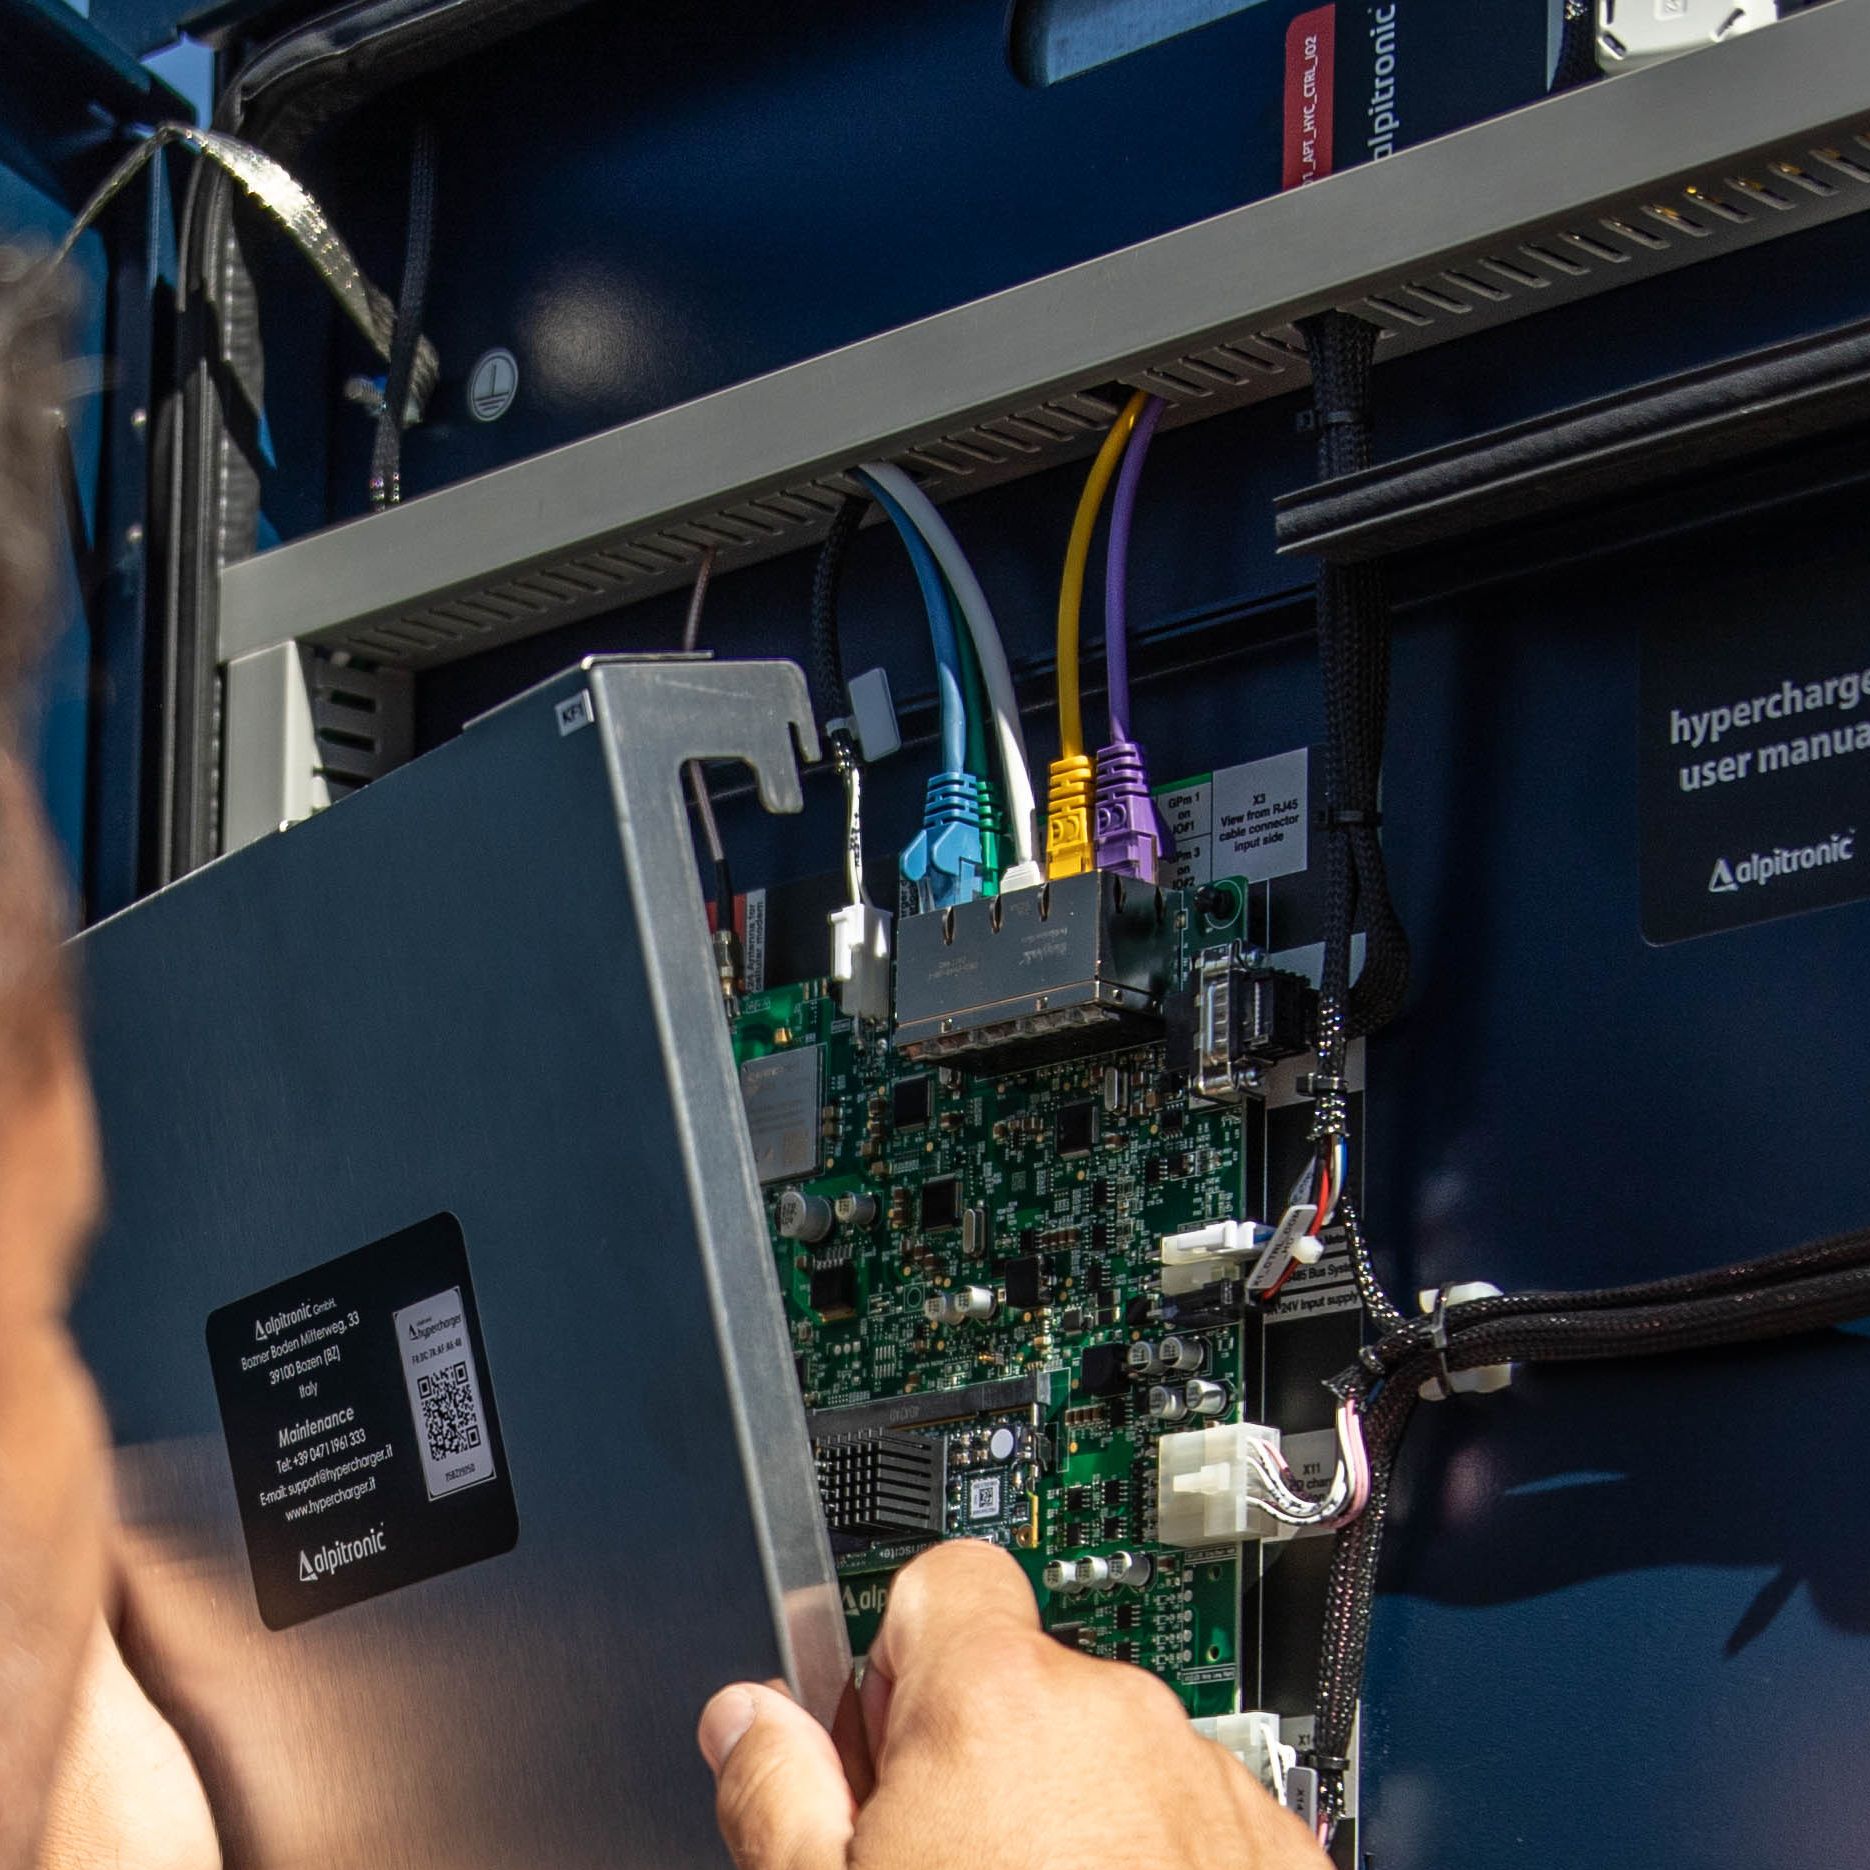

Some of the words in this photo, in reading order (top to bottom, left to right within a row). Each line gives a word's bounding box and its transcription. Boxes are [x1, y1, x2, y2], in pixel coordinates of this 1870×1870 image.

[1679, 750, 1751, 792] user
[1220, 813, 1245, 827] View
[1246, 807, 1271, 821] from
[1273, 799, 1299, 815] RJ45
[1253, 793, 1266, 806] X3
[1178, 810, 1191, 820] on
[1219, 827, 1246, 842] cable
[1248, 814, 1300, 834] connector
[1234, 838, 1260, 853] input
[1262, 831, 1284, 846] side
[1177, 865, 1190, 875] on
[1736, 832, 1855, 887] alpitronic
[1309, 1267, 1326, 1279] Bus
[1327, 1293, 1358, 1306] supply
[265, 1302, 312, 1335] alpitronic
[270, 1337, 300, 1358] Boden
[300, 1320, 348, 1347] Mitterweg,
[347, 1310, 360, 1327] 33
[269, 1363, 296, 1385] 39100
[295, 1354, 323, 1374] Bozen
[299, 1381, 318, 1399] Italy
[278, 1406, 354, 1448] Maintenance
[292, 1450, 309, 1467] +39
[309, 1442, 330, 1461] 0471
[330, 1435, 348, 1453] 1961
[349, 1428, 367, 1446] 333
[287, 1443, 393, 1495] support@hypercharger.it
[1302, 1463, 1320, 1475] X11
[284, 1476, 376, 1521] www.hypercharger.it
[315, 1527, 387, 1576] alpitronic
